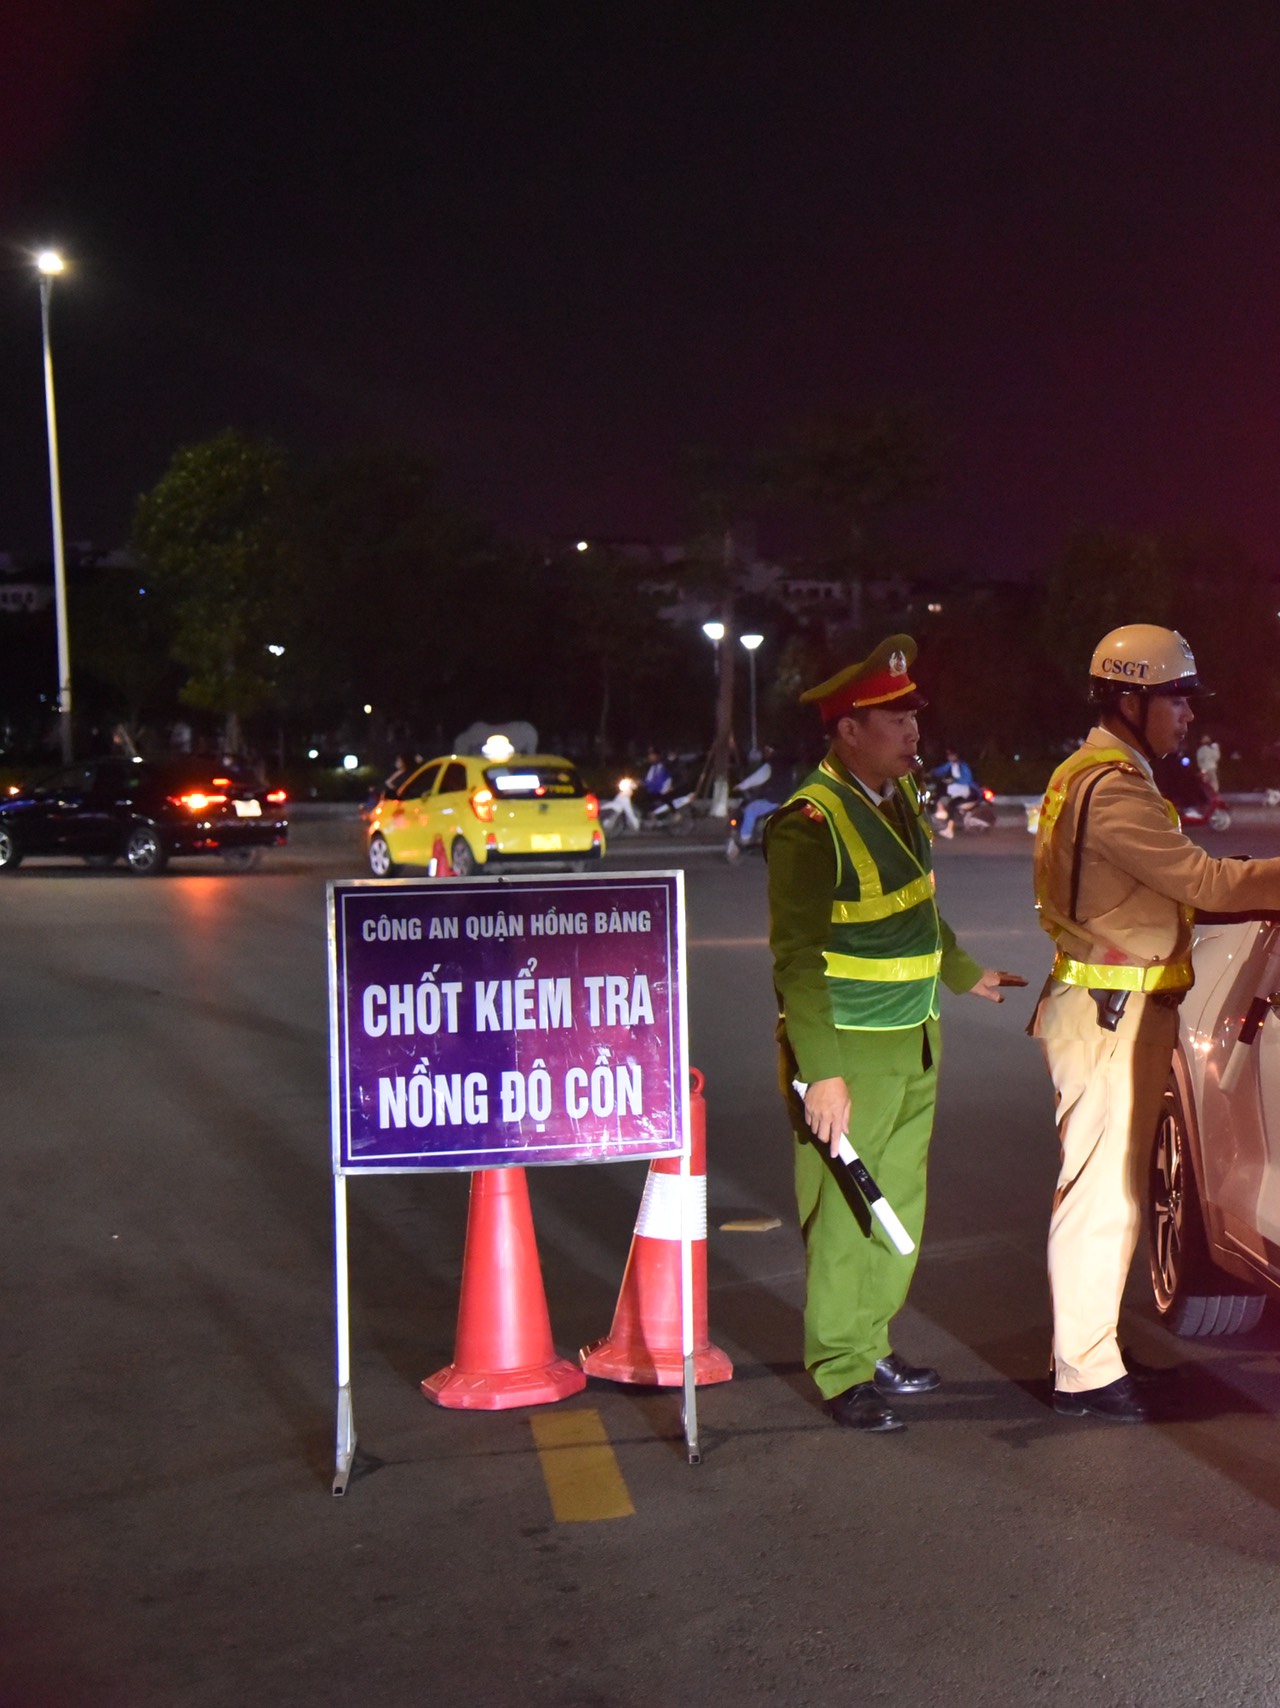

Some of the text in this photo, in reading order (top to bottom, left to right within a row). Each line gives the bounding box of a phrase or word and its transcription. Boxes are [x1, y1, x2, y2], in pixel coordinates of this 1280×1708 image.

[1102, 657, 1149, 679] CSGT
[362, 906, 651, 942] CÔNG AN QUẬN HỒNG BÀNG
[362, 957, 655, 1038] CHỐT KIỂM TRA
[378, 1047, 643, 1133] NỒNG ĐỘ CỒN
